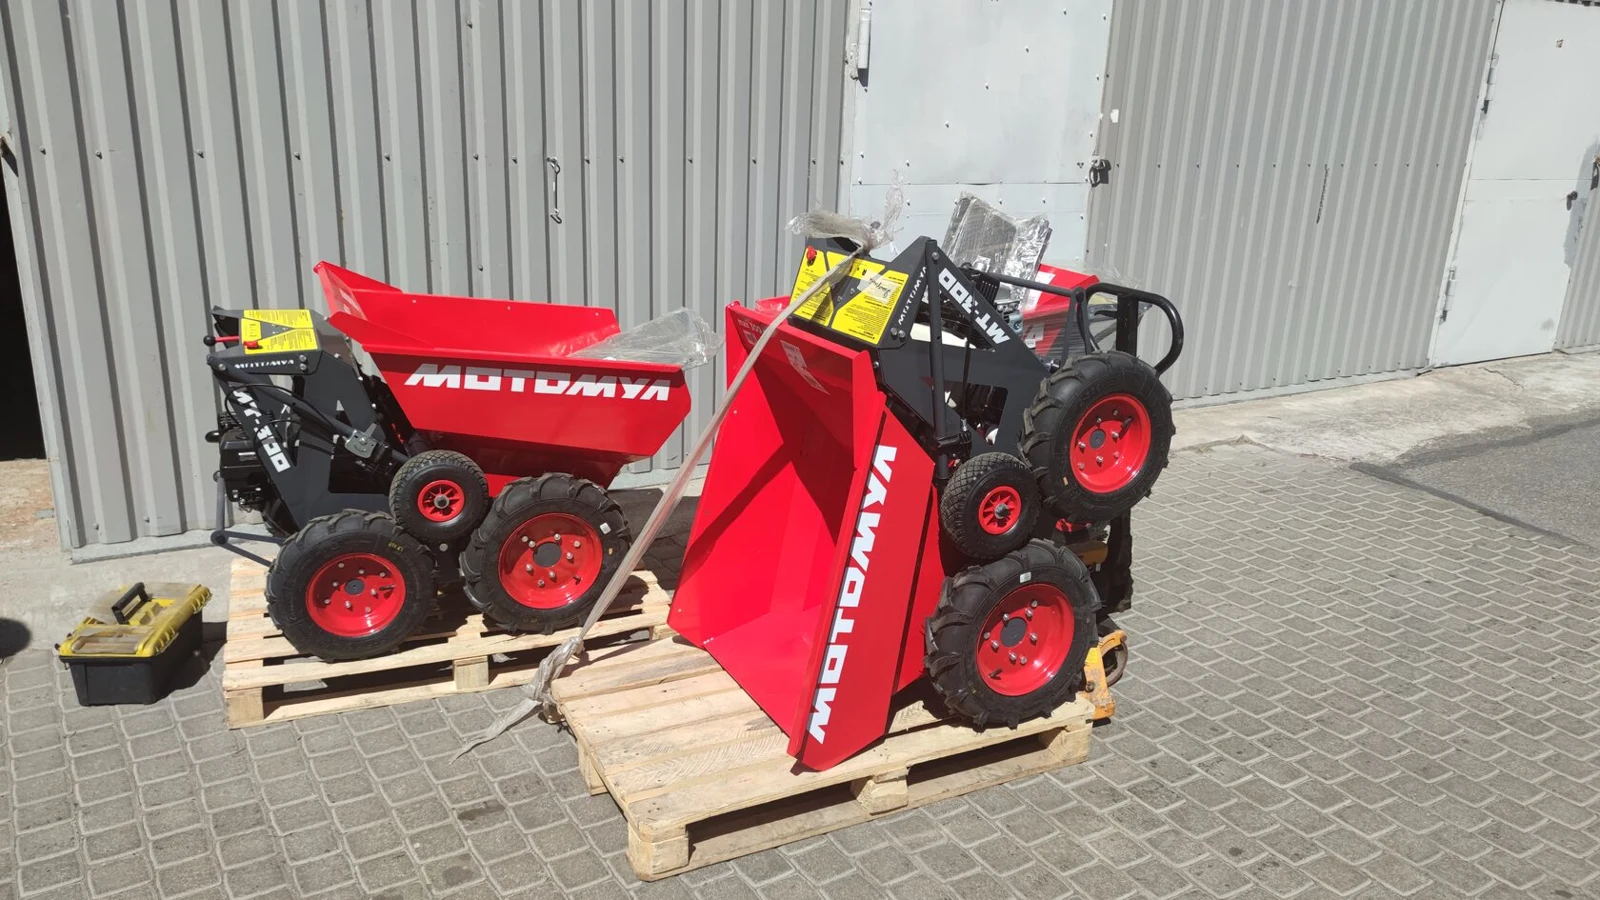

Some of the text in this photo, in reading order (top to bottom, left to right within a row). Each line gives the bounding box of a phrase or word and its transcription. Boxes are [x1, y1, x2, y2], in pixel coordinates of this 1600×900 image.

[938, 267, 1011, 344] MT-300
[404, 363, 671, 401] MOTOMYA
[232, 390, 291, 473] MT-300
[807, 444, 898, 745] MOTOMYA
